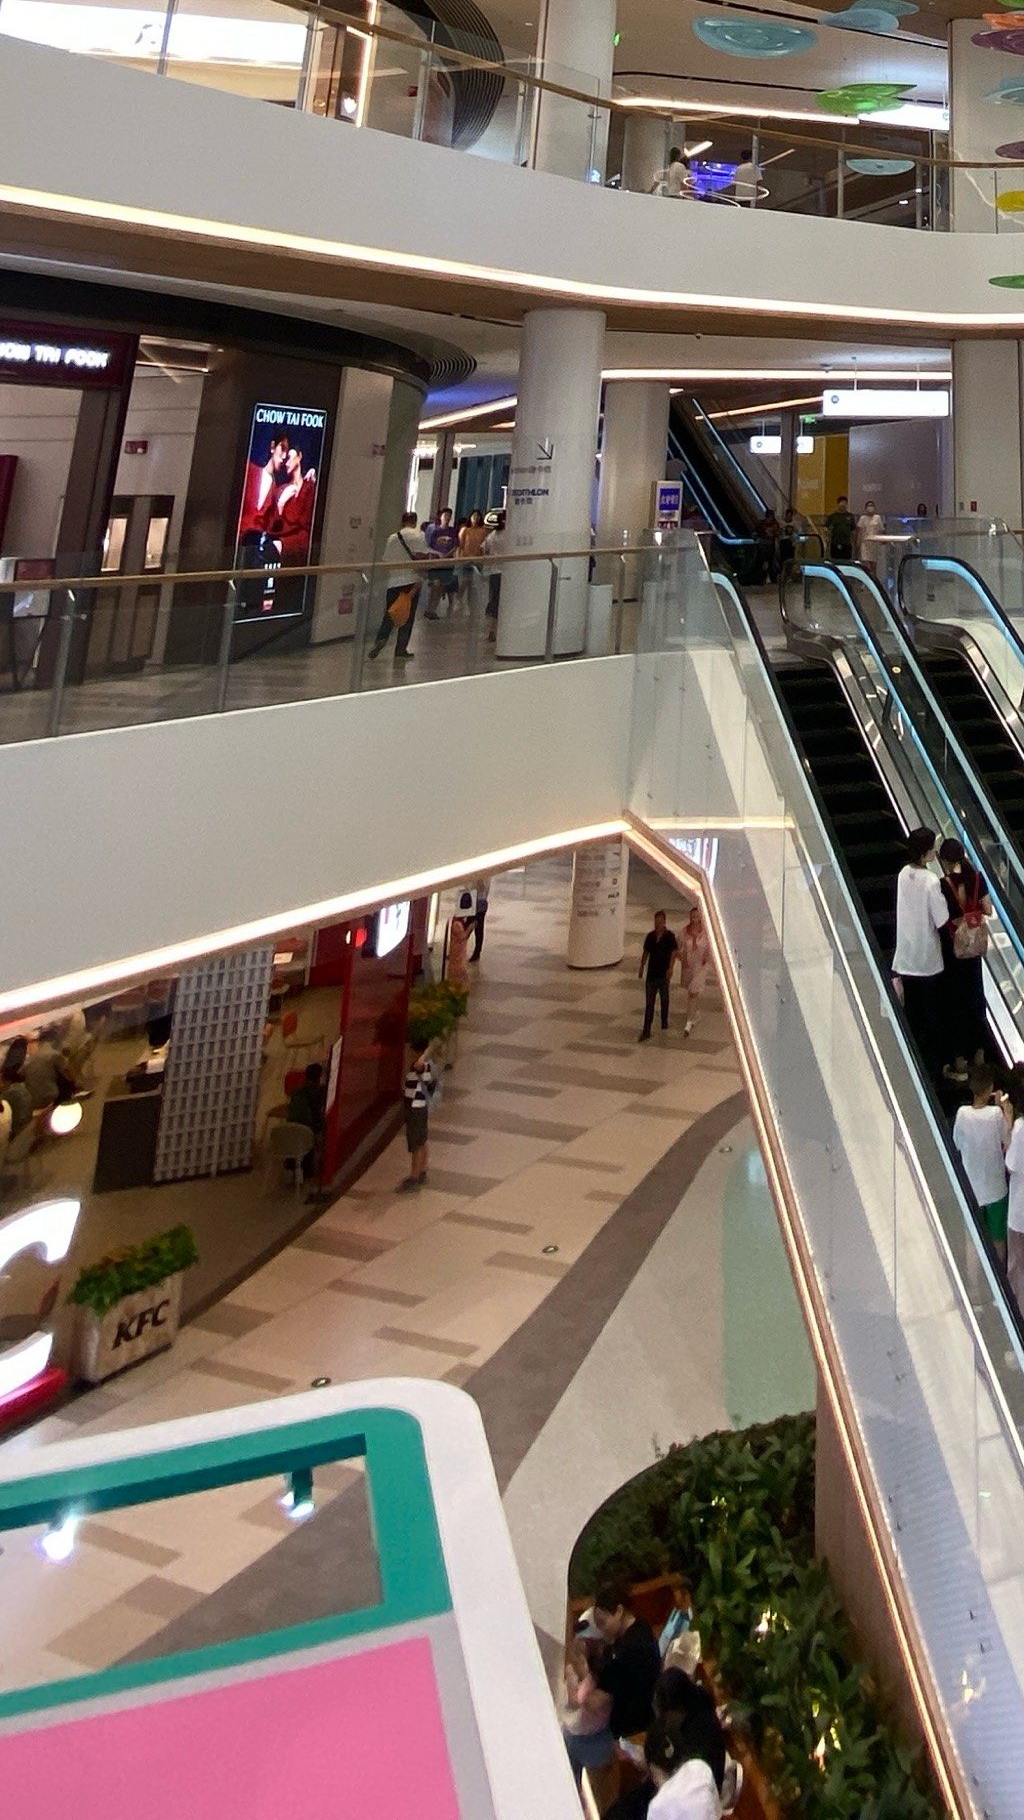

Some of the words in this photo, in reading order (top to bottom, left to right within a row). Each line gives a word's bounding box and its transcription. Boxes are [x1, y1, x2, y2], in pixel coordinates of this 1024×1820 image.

[64, 347, 109, 368] FOOK
[256, 408, 286, 424] CHOW
[286, 411, 300, 426] TAI
[301, 413, 324, 428] FOOK
[111, 1299, 170, 1351] KFC
